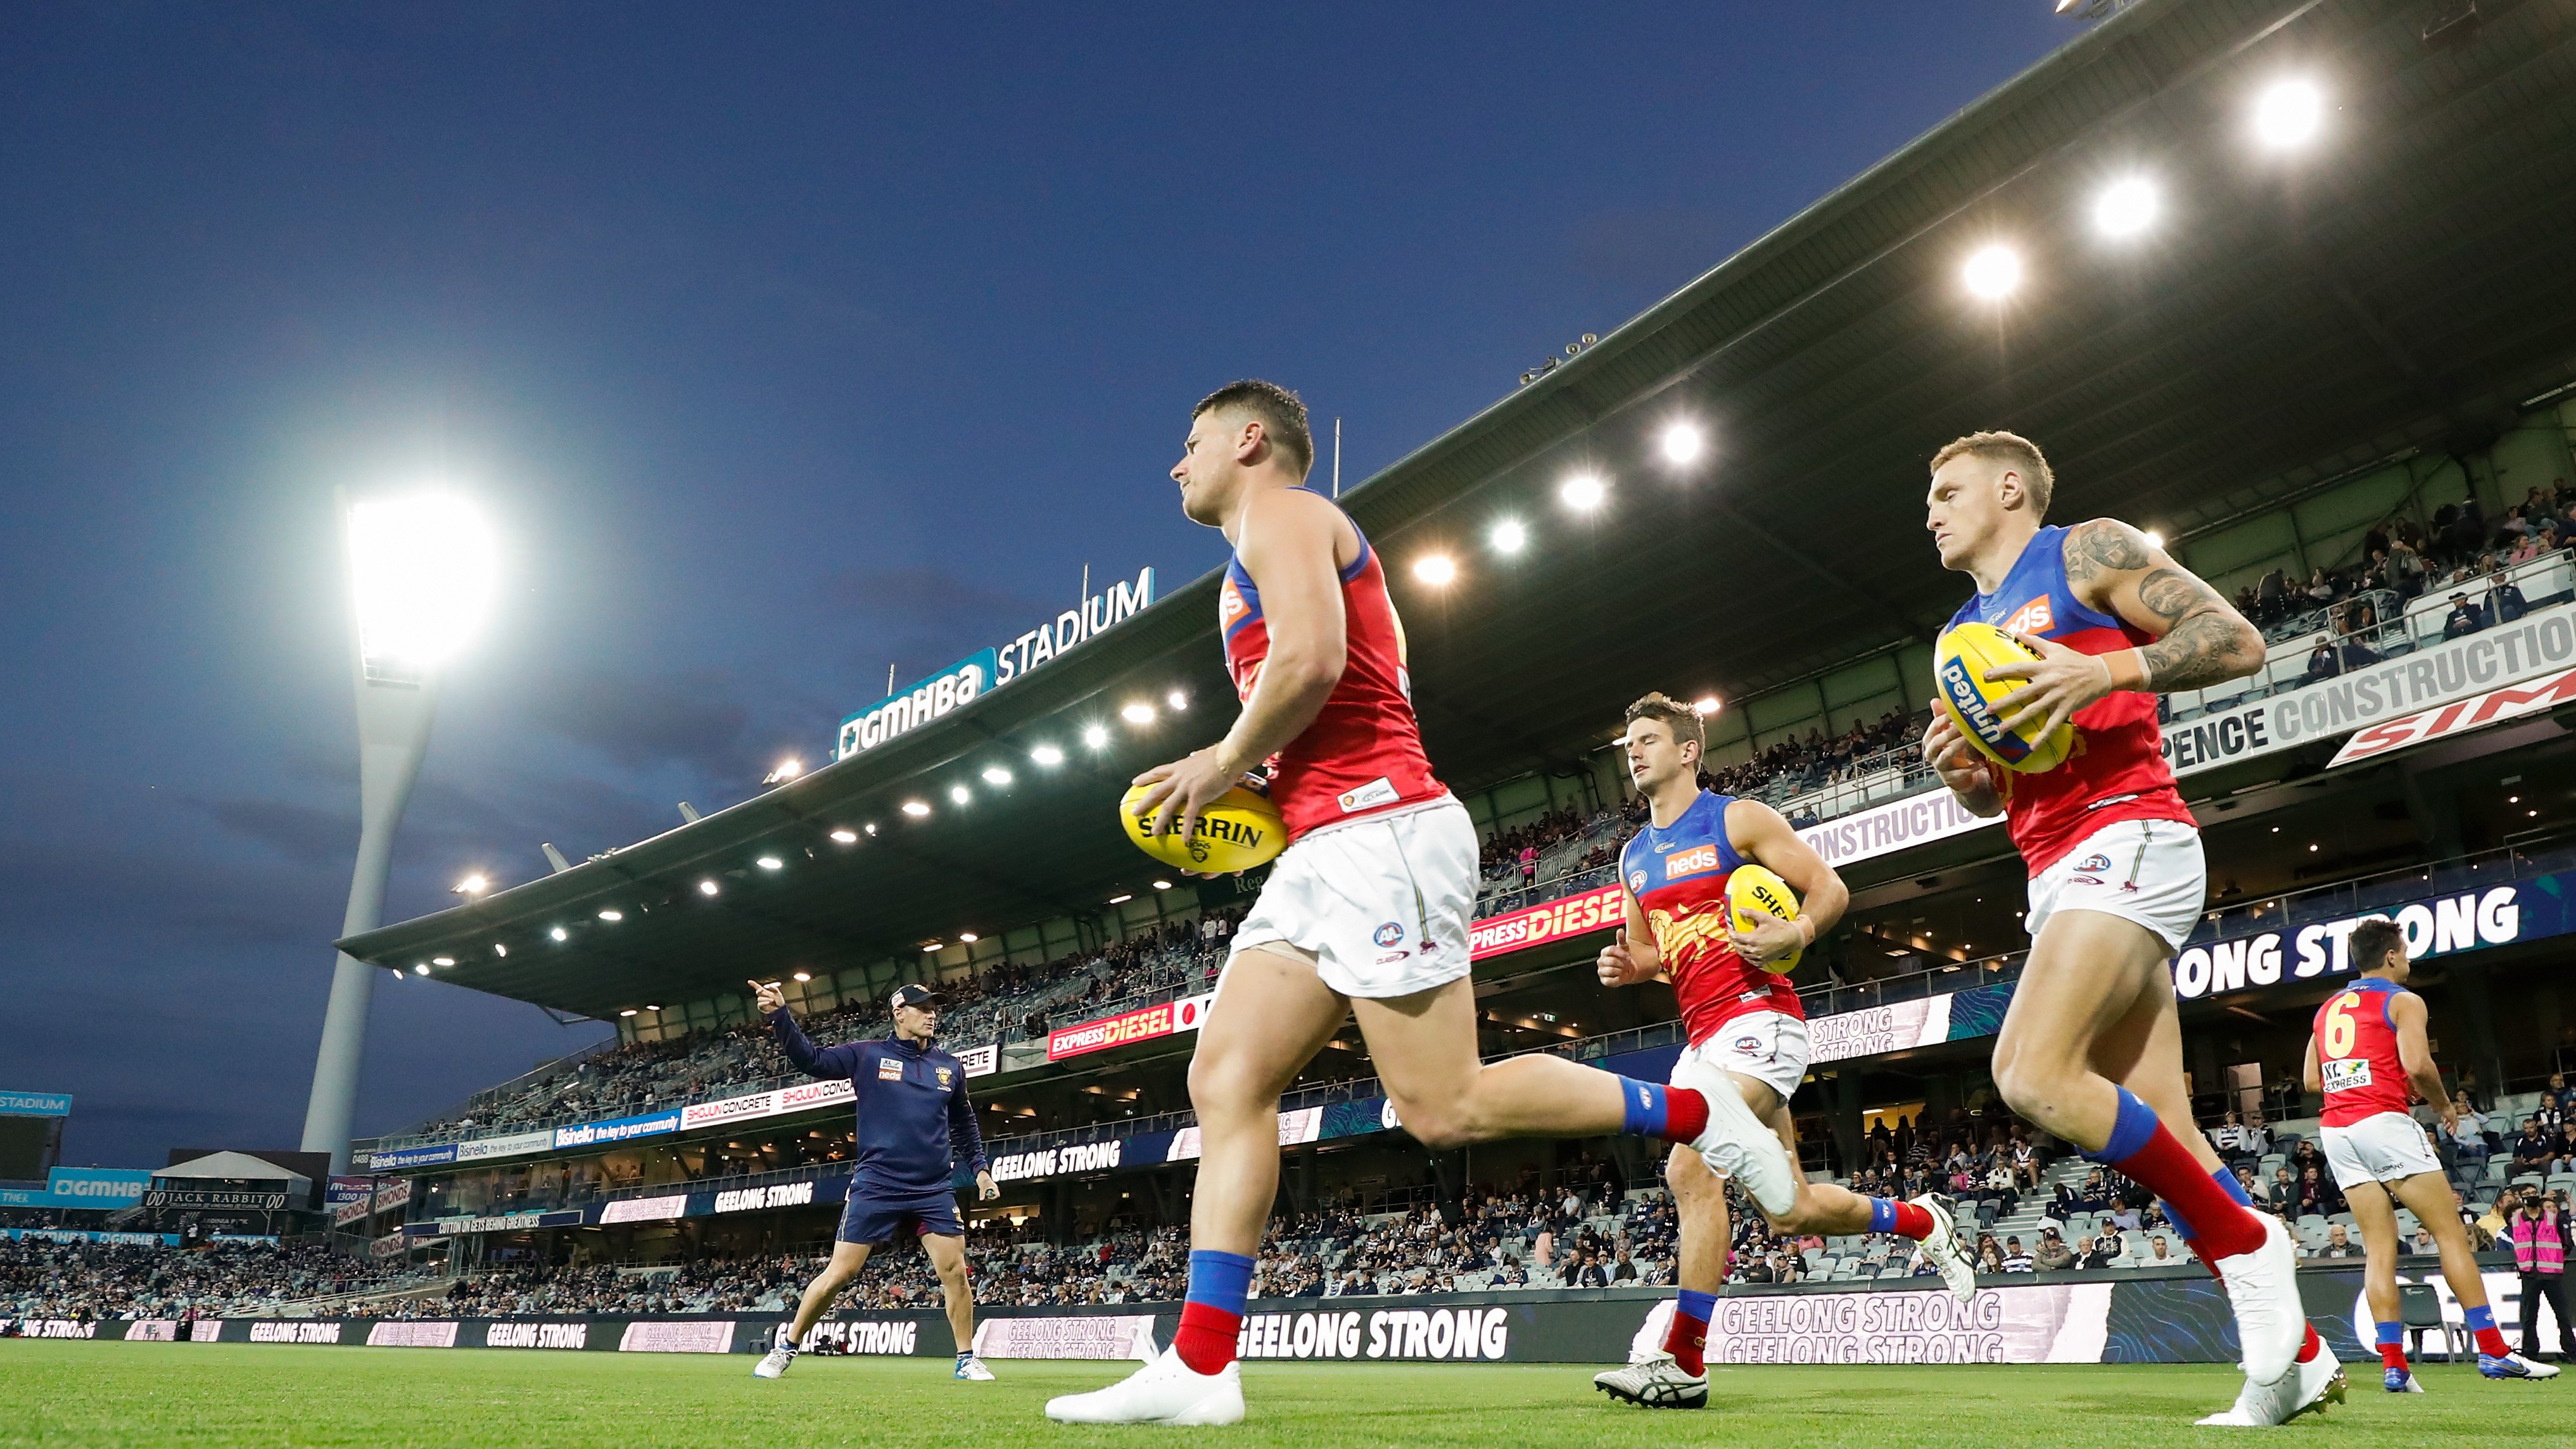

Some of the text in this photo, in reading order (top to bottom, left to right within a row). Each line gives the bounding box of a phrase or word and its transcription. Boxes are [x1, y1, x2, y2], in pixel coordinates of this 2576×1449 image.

[996, 566, 1154, 687] STADIUM
[2274, 612, 2576, 741] CONSTRUCTIO
[1138, 815, 1264, 848] SERRIN
[1666, 850, 1717, 876] neds
[1469, 920, 1527, 951] PRESS
[1052, 1008, 1172, 1053] EXPRESS DIESEL
[1813, 1008, 1892, 1044] STRONG
[2325, 992, 2361, 1059] 6
[879, 1071, 901, 1079] neds
[687, 1096, 771, 1120] SHOJUN CONCRETE
[782, 1086, 822, 1104] SHOJUN
[555, 1115, 678, 1148] Bisinella the key to your community
[370, 1154, 397, 1169] Bisinella
[459, 1142, 488, 1158] Bisinella
[991, 1140, 1121, 1182] GEELONG STRONG
[167, 1193, 205, 1203] JACK
[212, 1194, 265, 1204] RABBIT
[715, 1181, 813, 1213] GEELONG STRONG
[439, 1215, 540, 1234] COTTON ON GETS BEHIND GREATNESS
[1722, 1293, 2000, 1334] GEELONG STRONG
[250, 1322, 340, 1343] GEELONG STRONG
[486, 1323, 587, 1349] GEELONG STRONG
[847, 1321, 917, 1354] STRONG
[1008, 1319, 1116, 1341] GEELONG STRONG
[1366, 1307, 1508, 1360] STRONG
[1724, 1332, 2003, 1364] GEELONG STRONG
